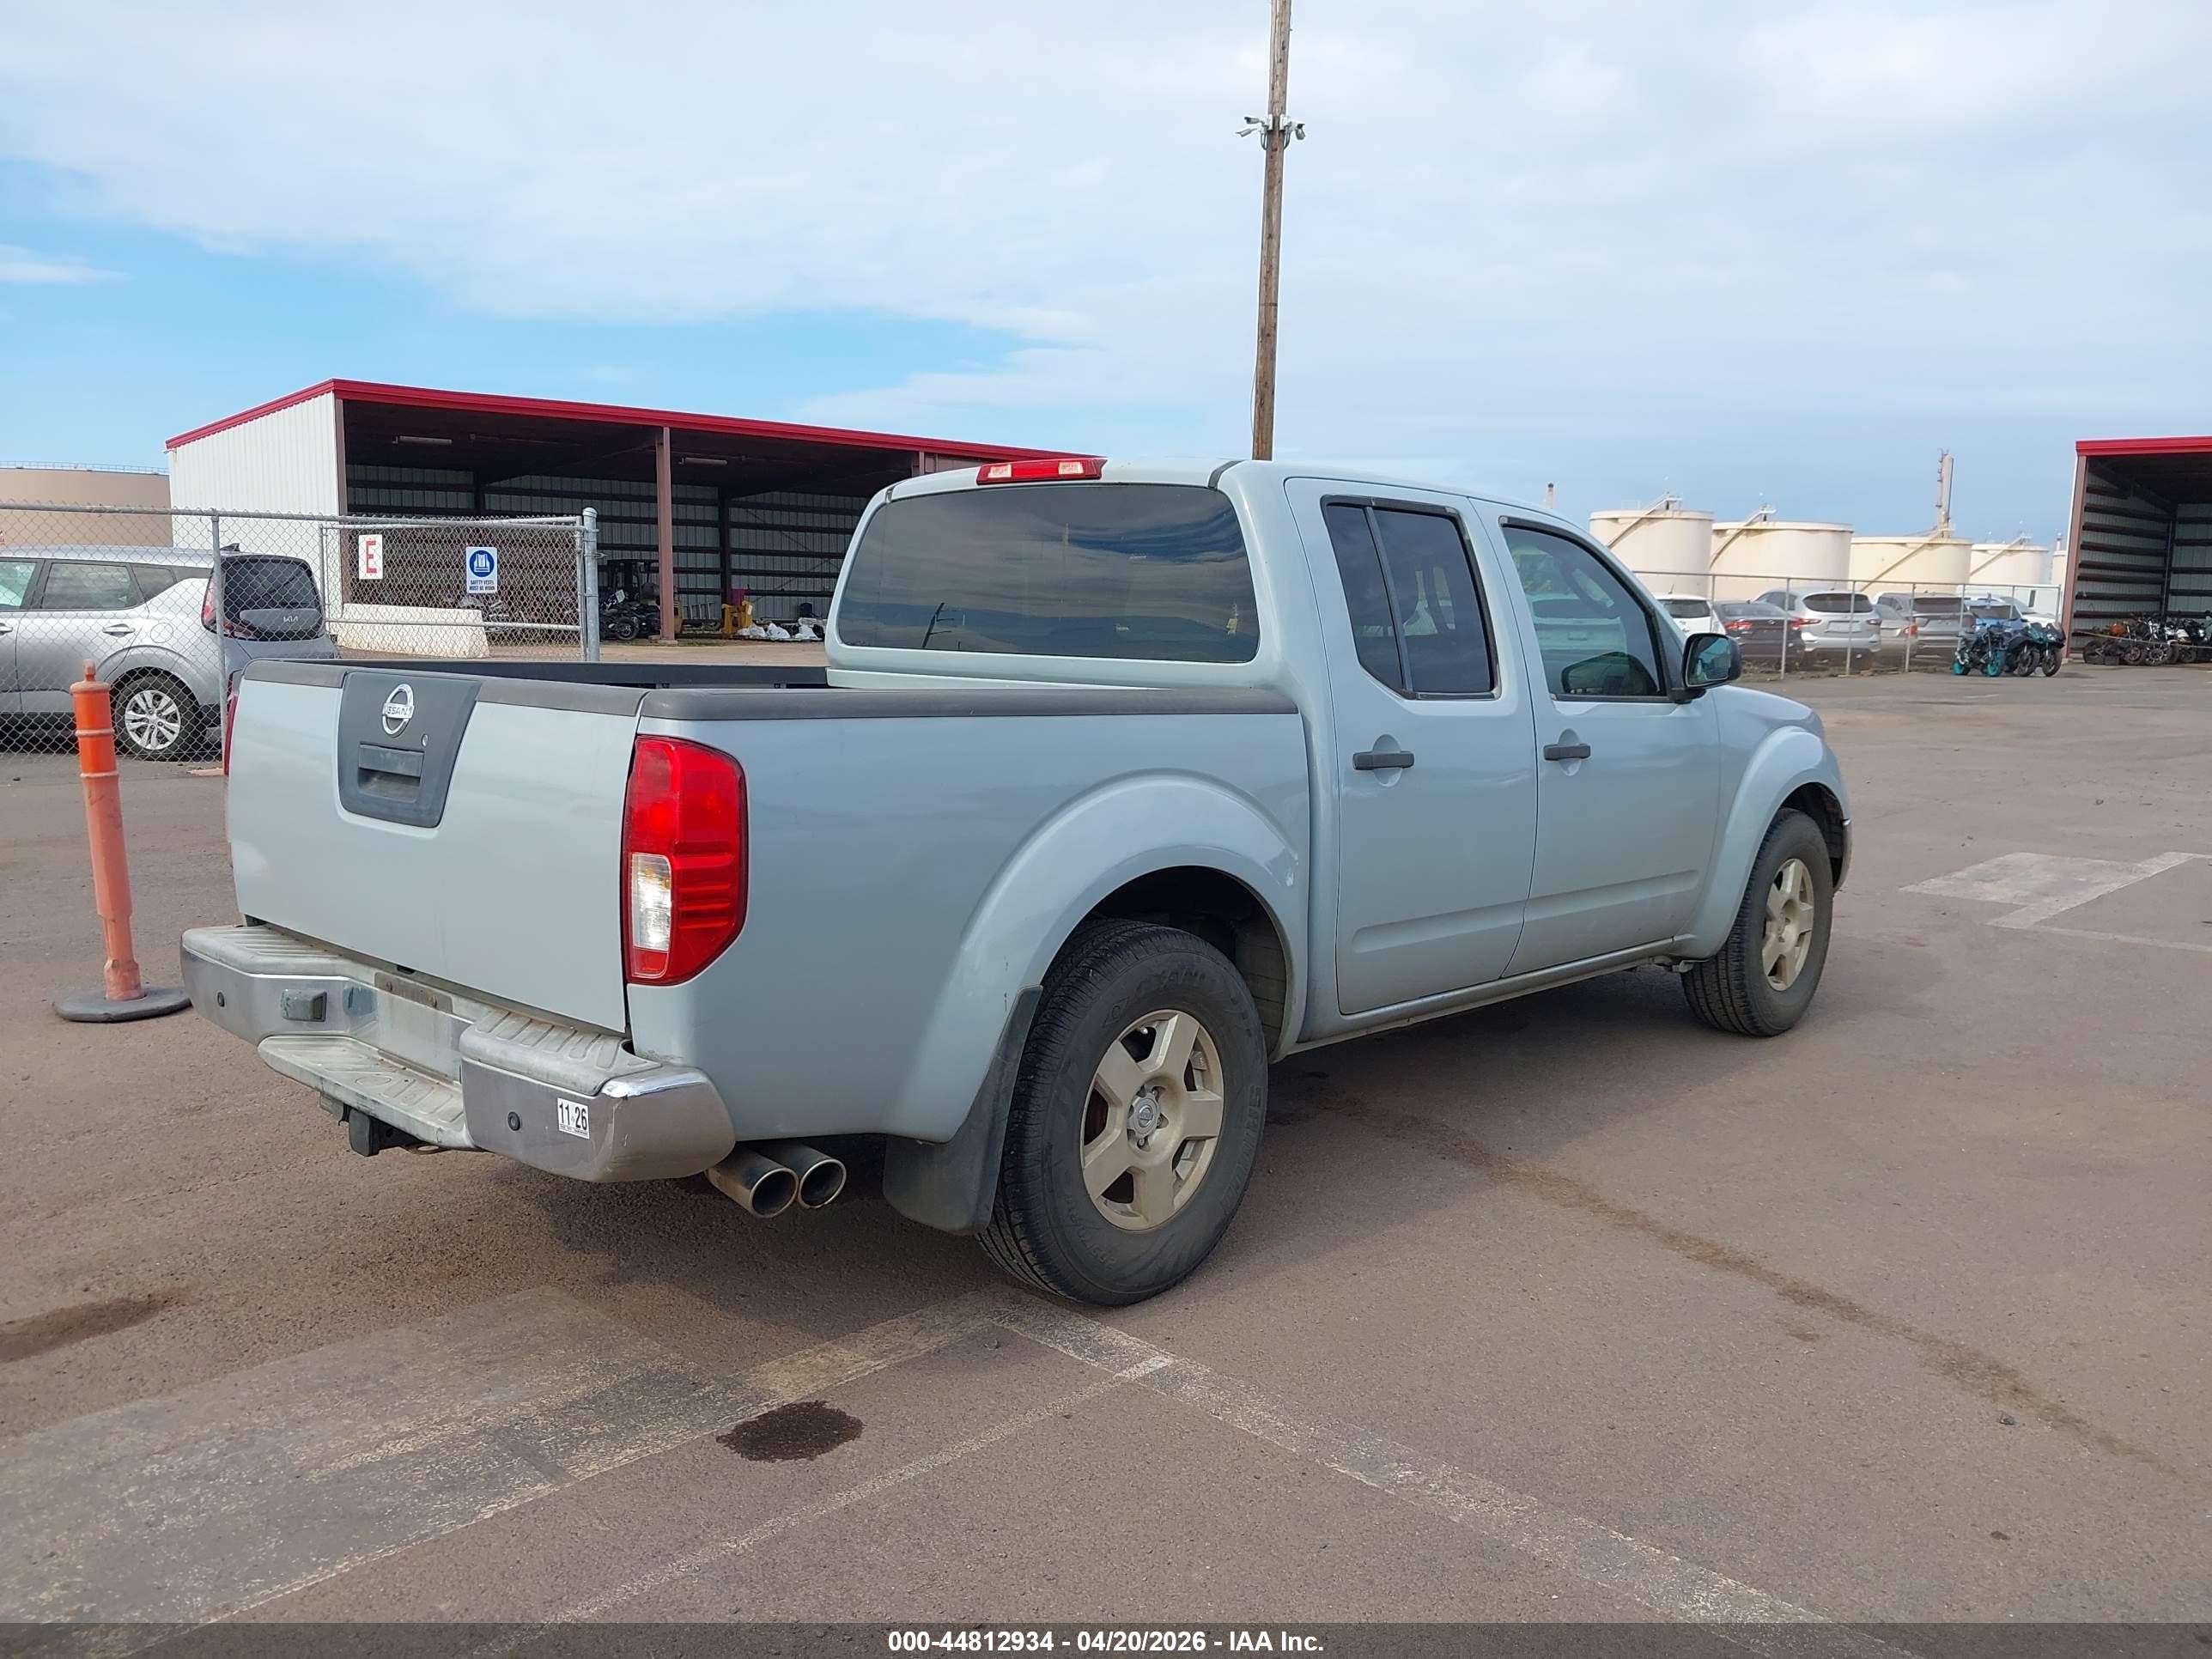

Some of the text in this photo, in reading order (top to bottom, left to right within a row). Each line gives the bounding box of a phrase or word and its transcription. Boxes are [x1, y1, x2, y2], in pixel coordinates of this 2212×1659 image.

[366, 540, 377, 573] E
[559, 1101, 570, 1126] 11
[574, 1106, 587, 1131] 26
